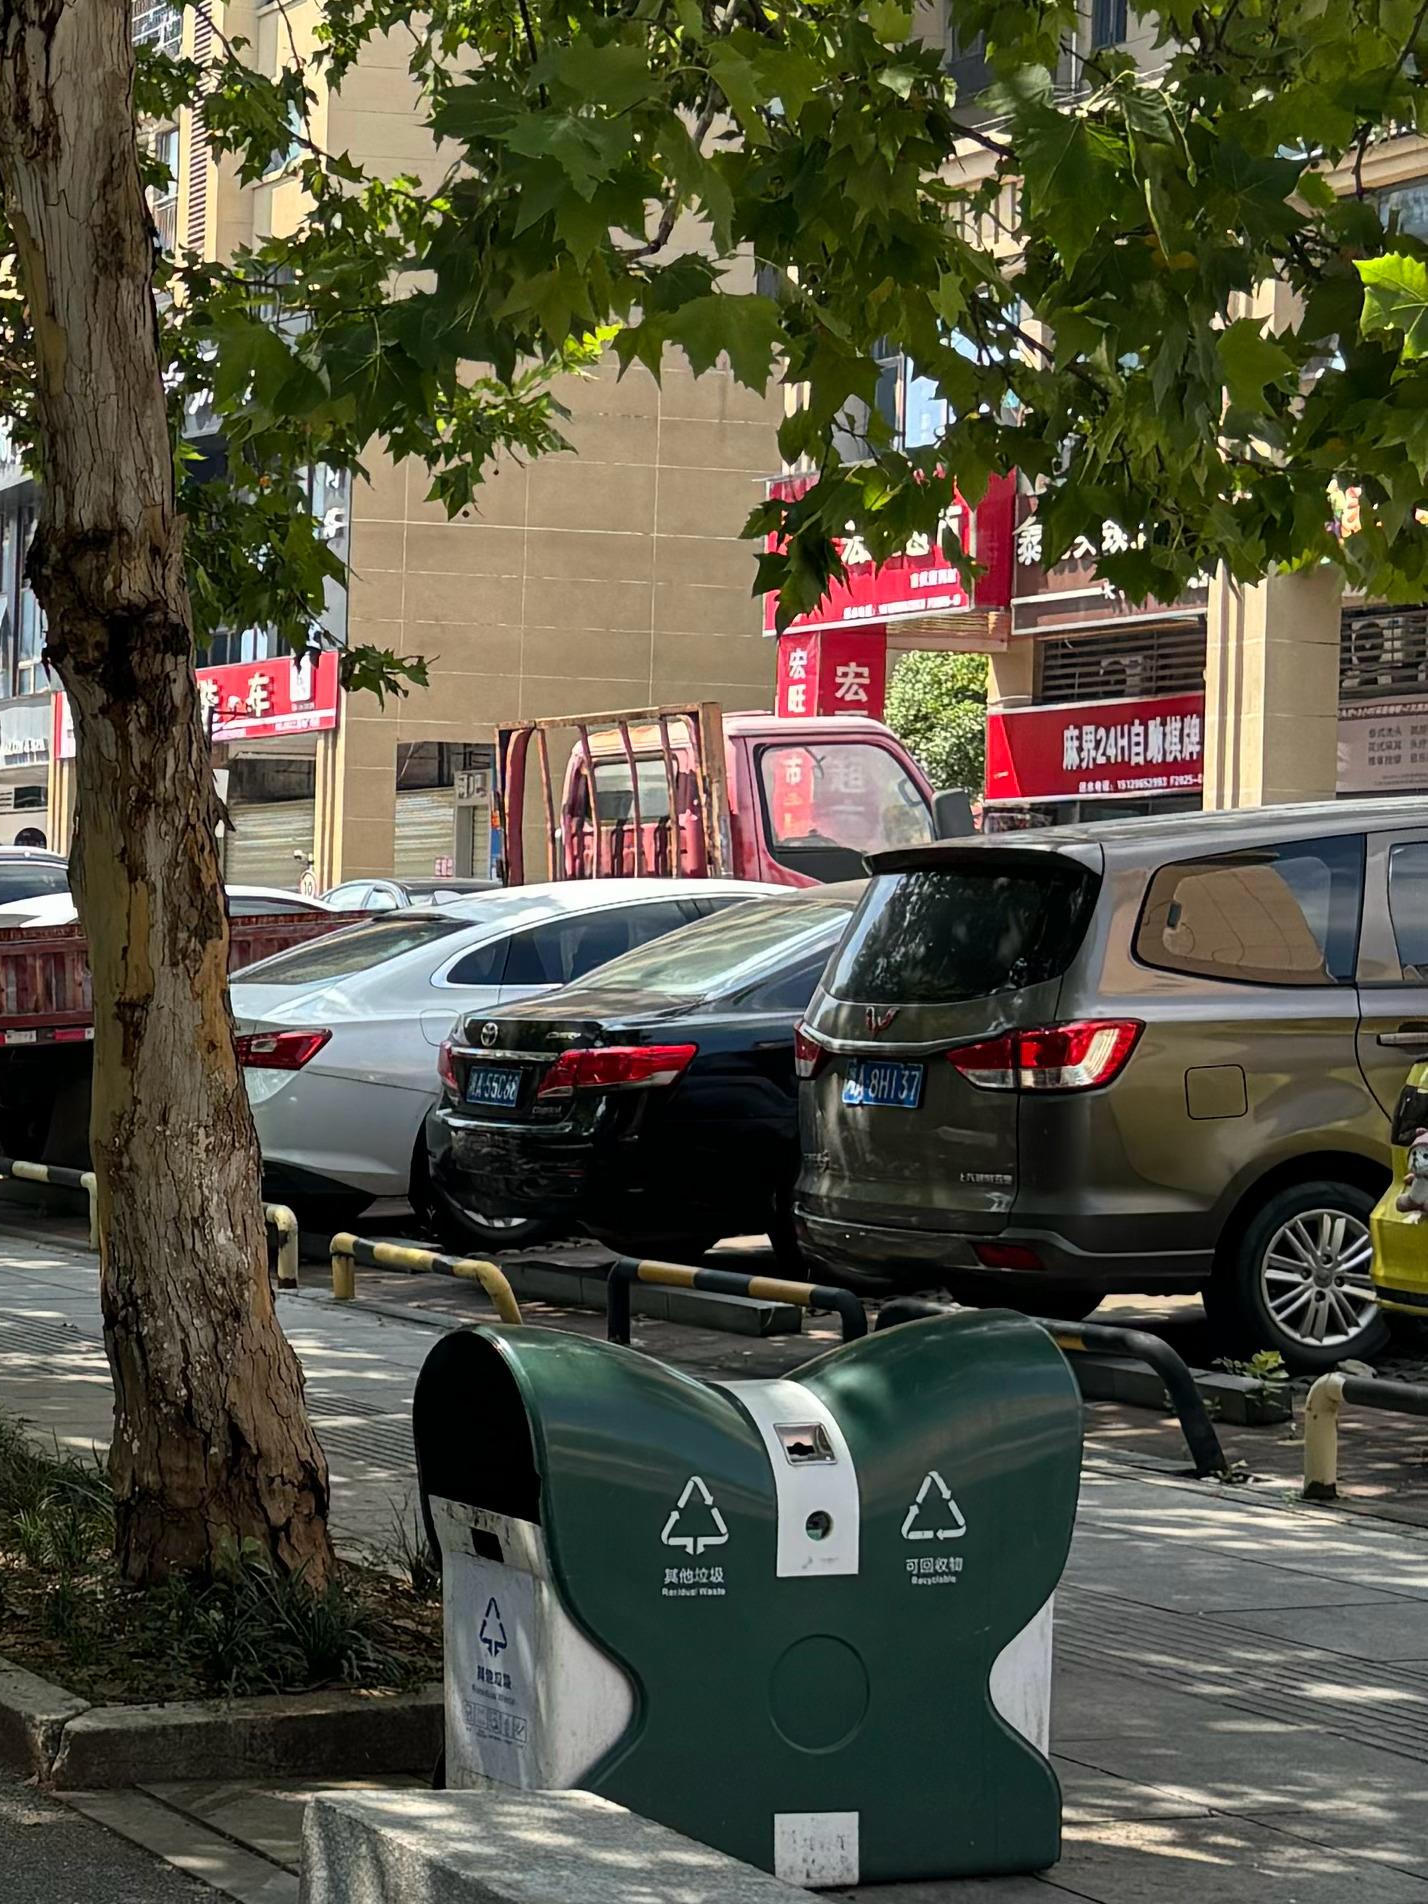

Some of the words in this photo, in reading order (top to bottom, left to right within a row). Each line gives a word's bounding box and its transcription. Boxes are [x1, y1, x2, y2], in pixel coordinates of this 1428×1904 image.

[905, 1556, 964, 1574] 可回收物
[664, 1566, 725, 1584] 其他垃圾
